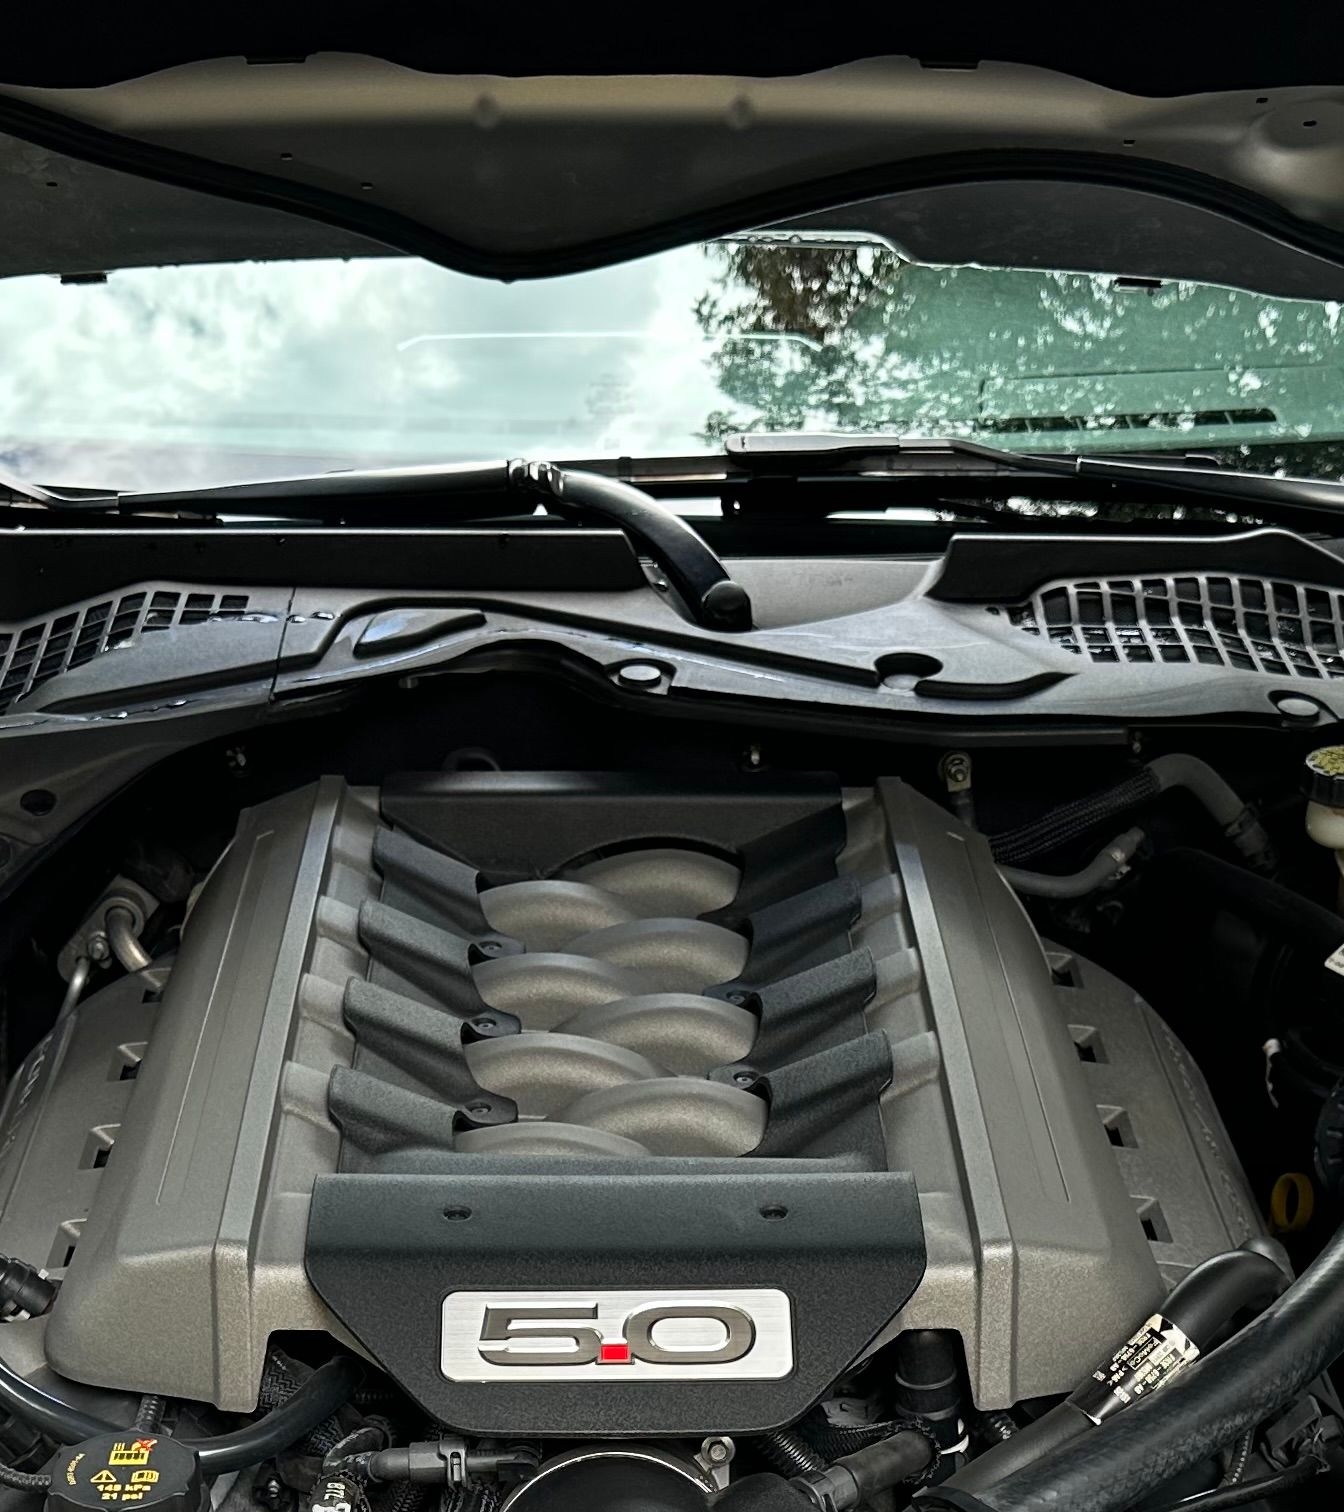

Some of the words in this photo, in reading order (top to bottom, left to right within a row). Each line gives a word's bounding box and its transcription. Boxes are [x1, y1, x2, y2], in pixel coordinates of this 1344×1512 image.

[478, 1299, 757, 1367] 5.0
[124, 1484, 151, 1492] kPa
[101, 1492, 118, 1500] 21
[121, 1492, 144, 1501] psi
